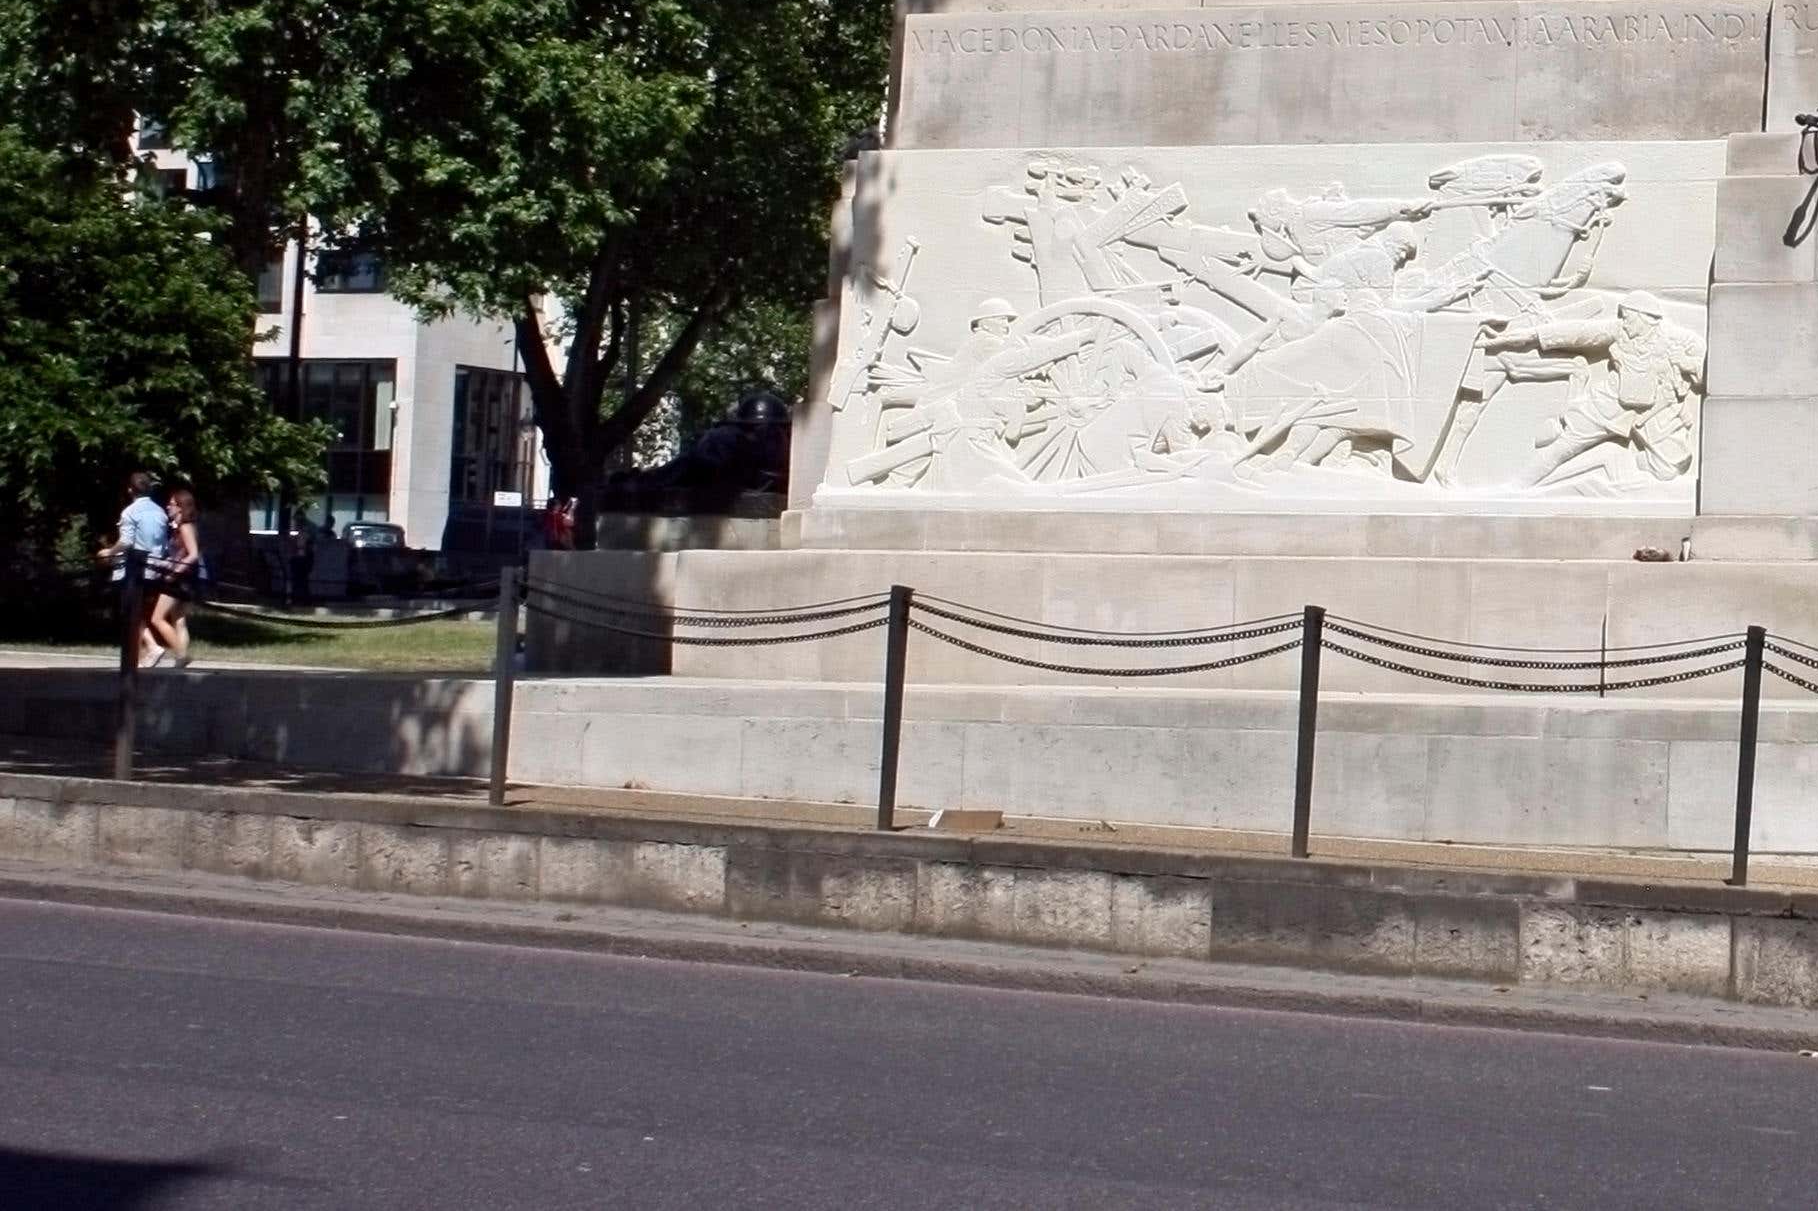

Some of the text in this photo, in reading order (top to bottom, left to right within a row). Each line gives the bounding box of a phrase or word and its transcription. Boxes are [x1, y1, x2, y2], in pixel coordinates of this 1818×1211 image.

[910, 26, 1100, 54] MACEDONIA
[1108, 21, 1319, 51] DARDANELLES
[1326, 17, 1554, 45] MESOPOTAMIA
[1556, 12, 1675, 42] ARABIA
